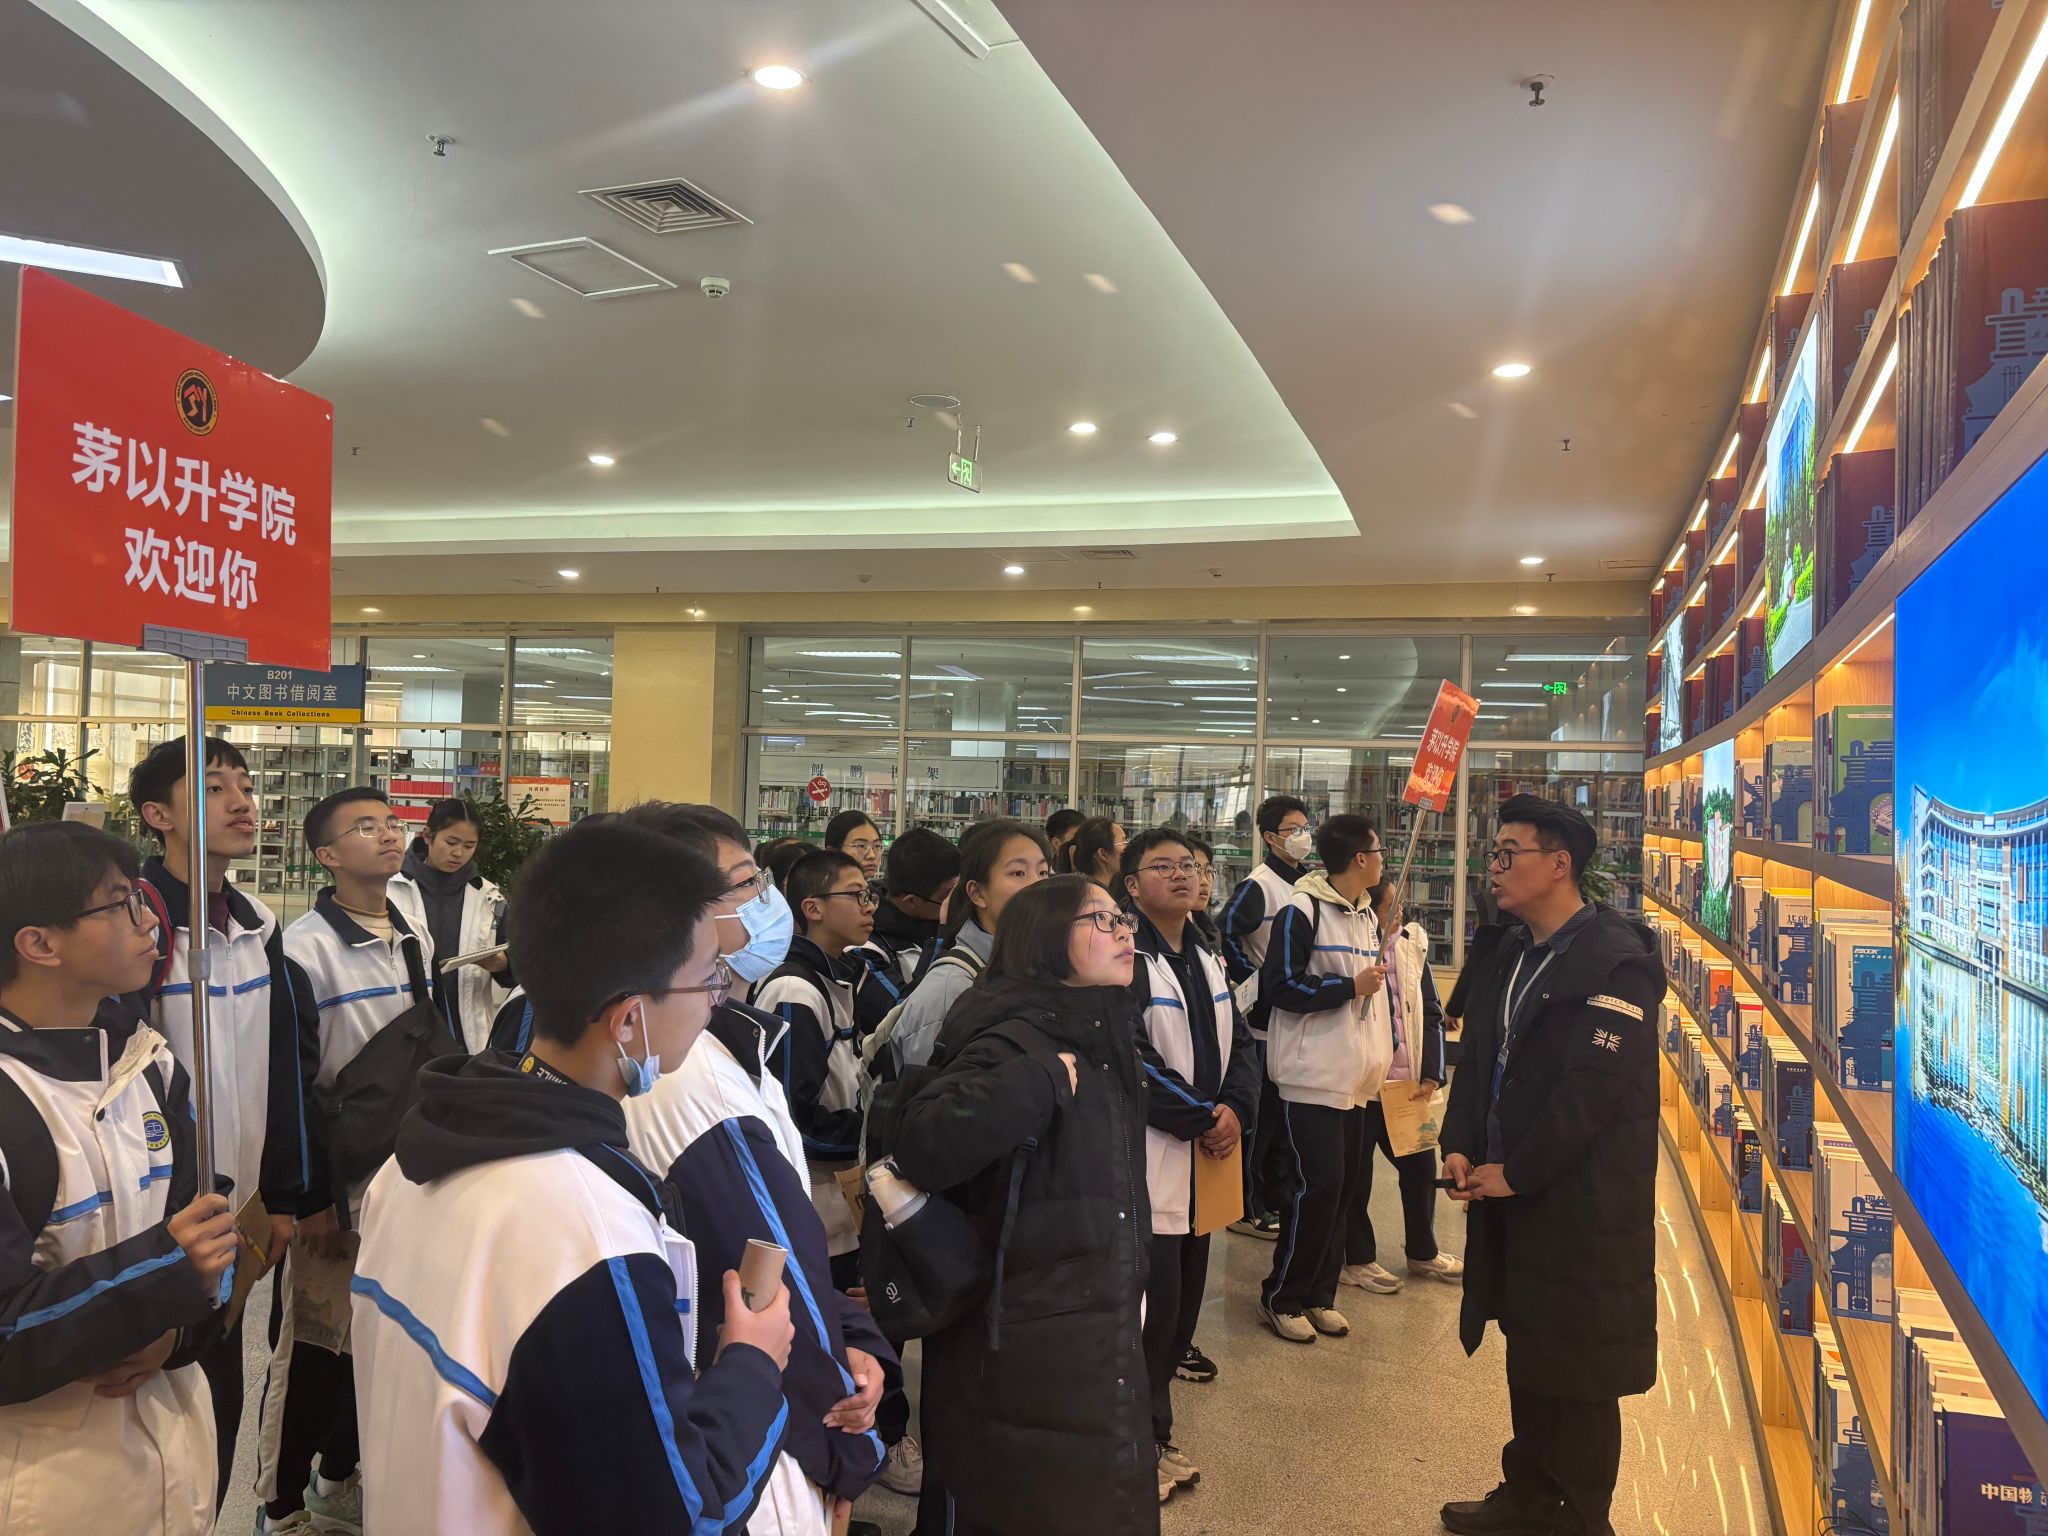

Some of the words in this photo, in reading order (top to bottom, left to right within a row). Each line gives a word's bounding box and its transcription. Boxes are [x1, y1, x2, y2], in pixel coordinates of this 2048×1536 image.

[72, 421, 297, 546] 茅以升学院
[124, 527, 258, 610] 欢迎你
[267, 670, 293, 680] B201
[227, 683, 337, 702] 中文图书借阅室
[286, 710, 330, 718] Collections
[536, 1067, 568, 1086] MILE
